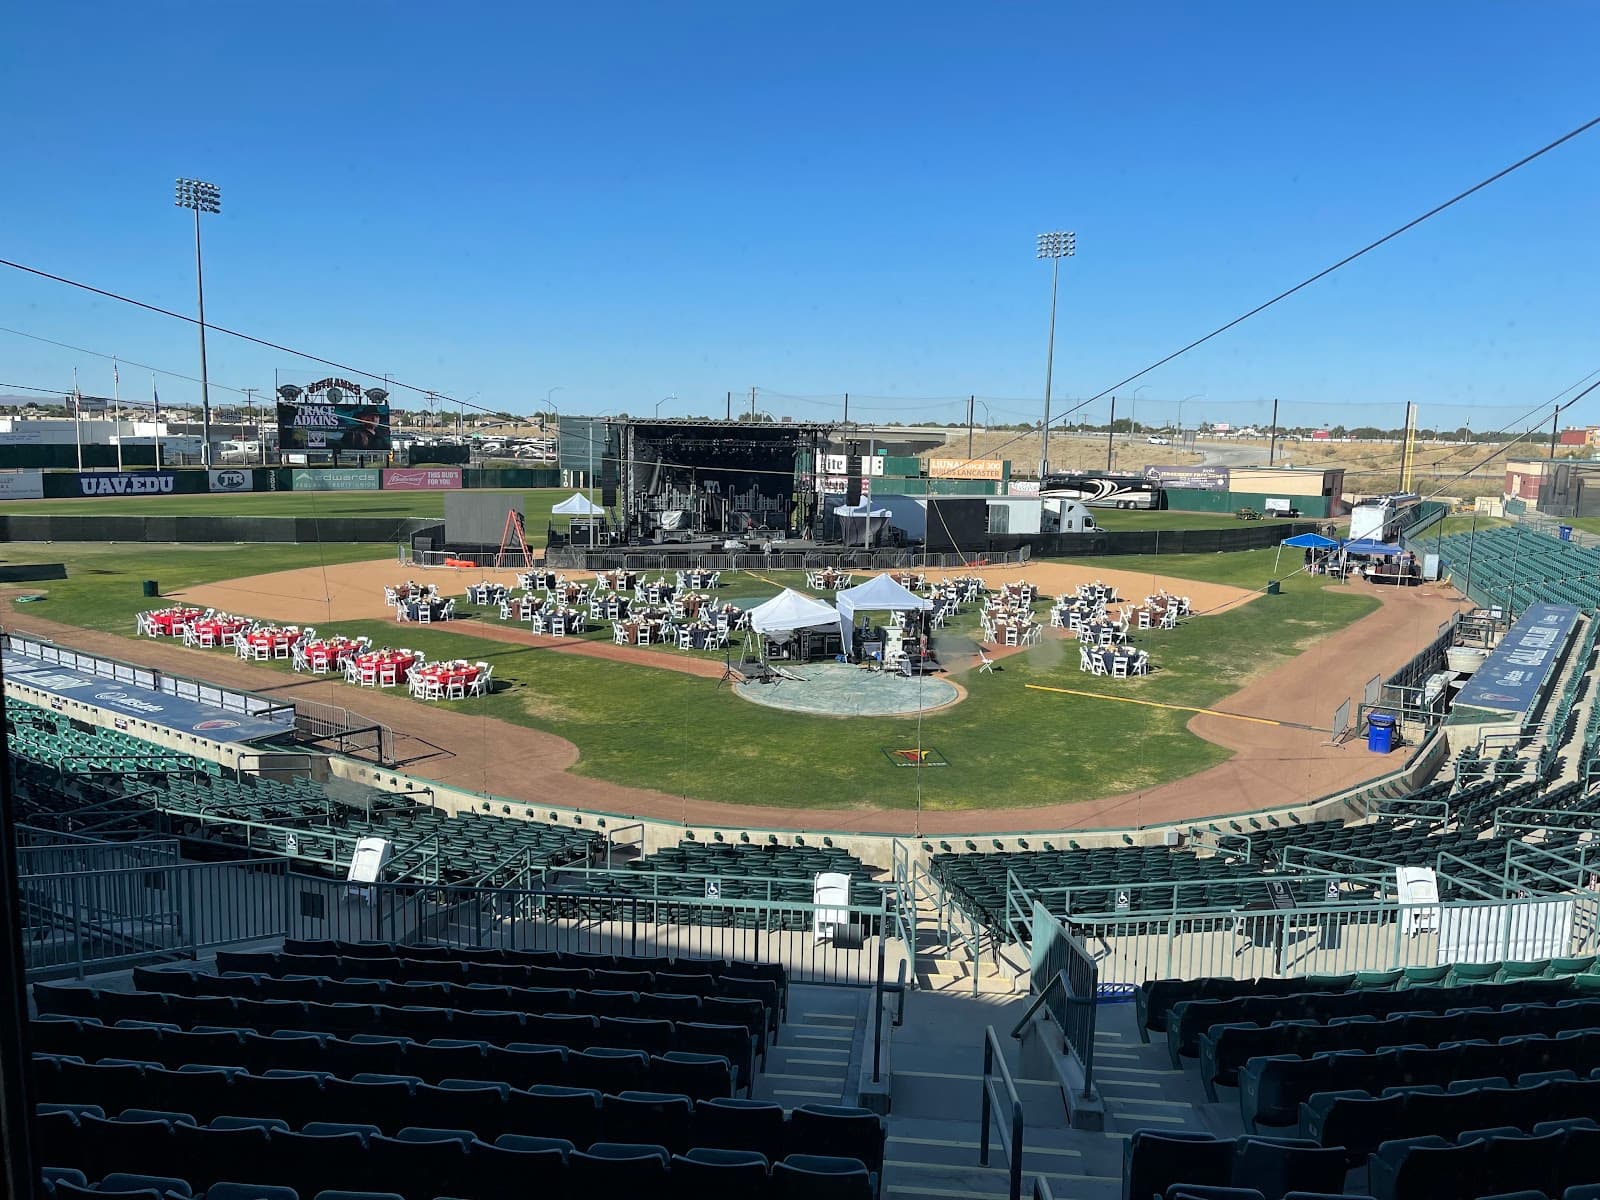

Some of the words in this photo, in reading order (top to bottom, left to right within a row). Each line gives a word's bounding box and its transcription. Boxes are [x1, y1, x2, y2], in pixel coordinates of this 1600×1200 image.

[297, 405, 336, 416] TRACE
[293, 415, 339, 426] ADKINS
[315, 472, 376, 481] edwards
[427, 471, 440, 479] THIS
[957, 469, 1000, 477] LANCASTER
[80, 476, 175, 496] UAV.EDU
